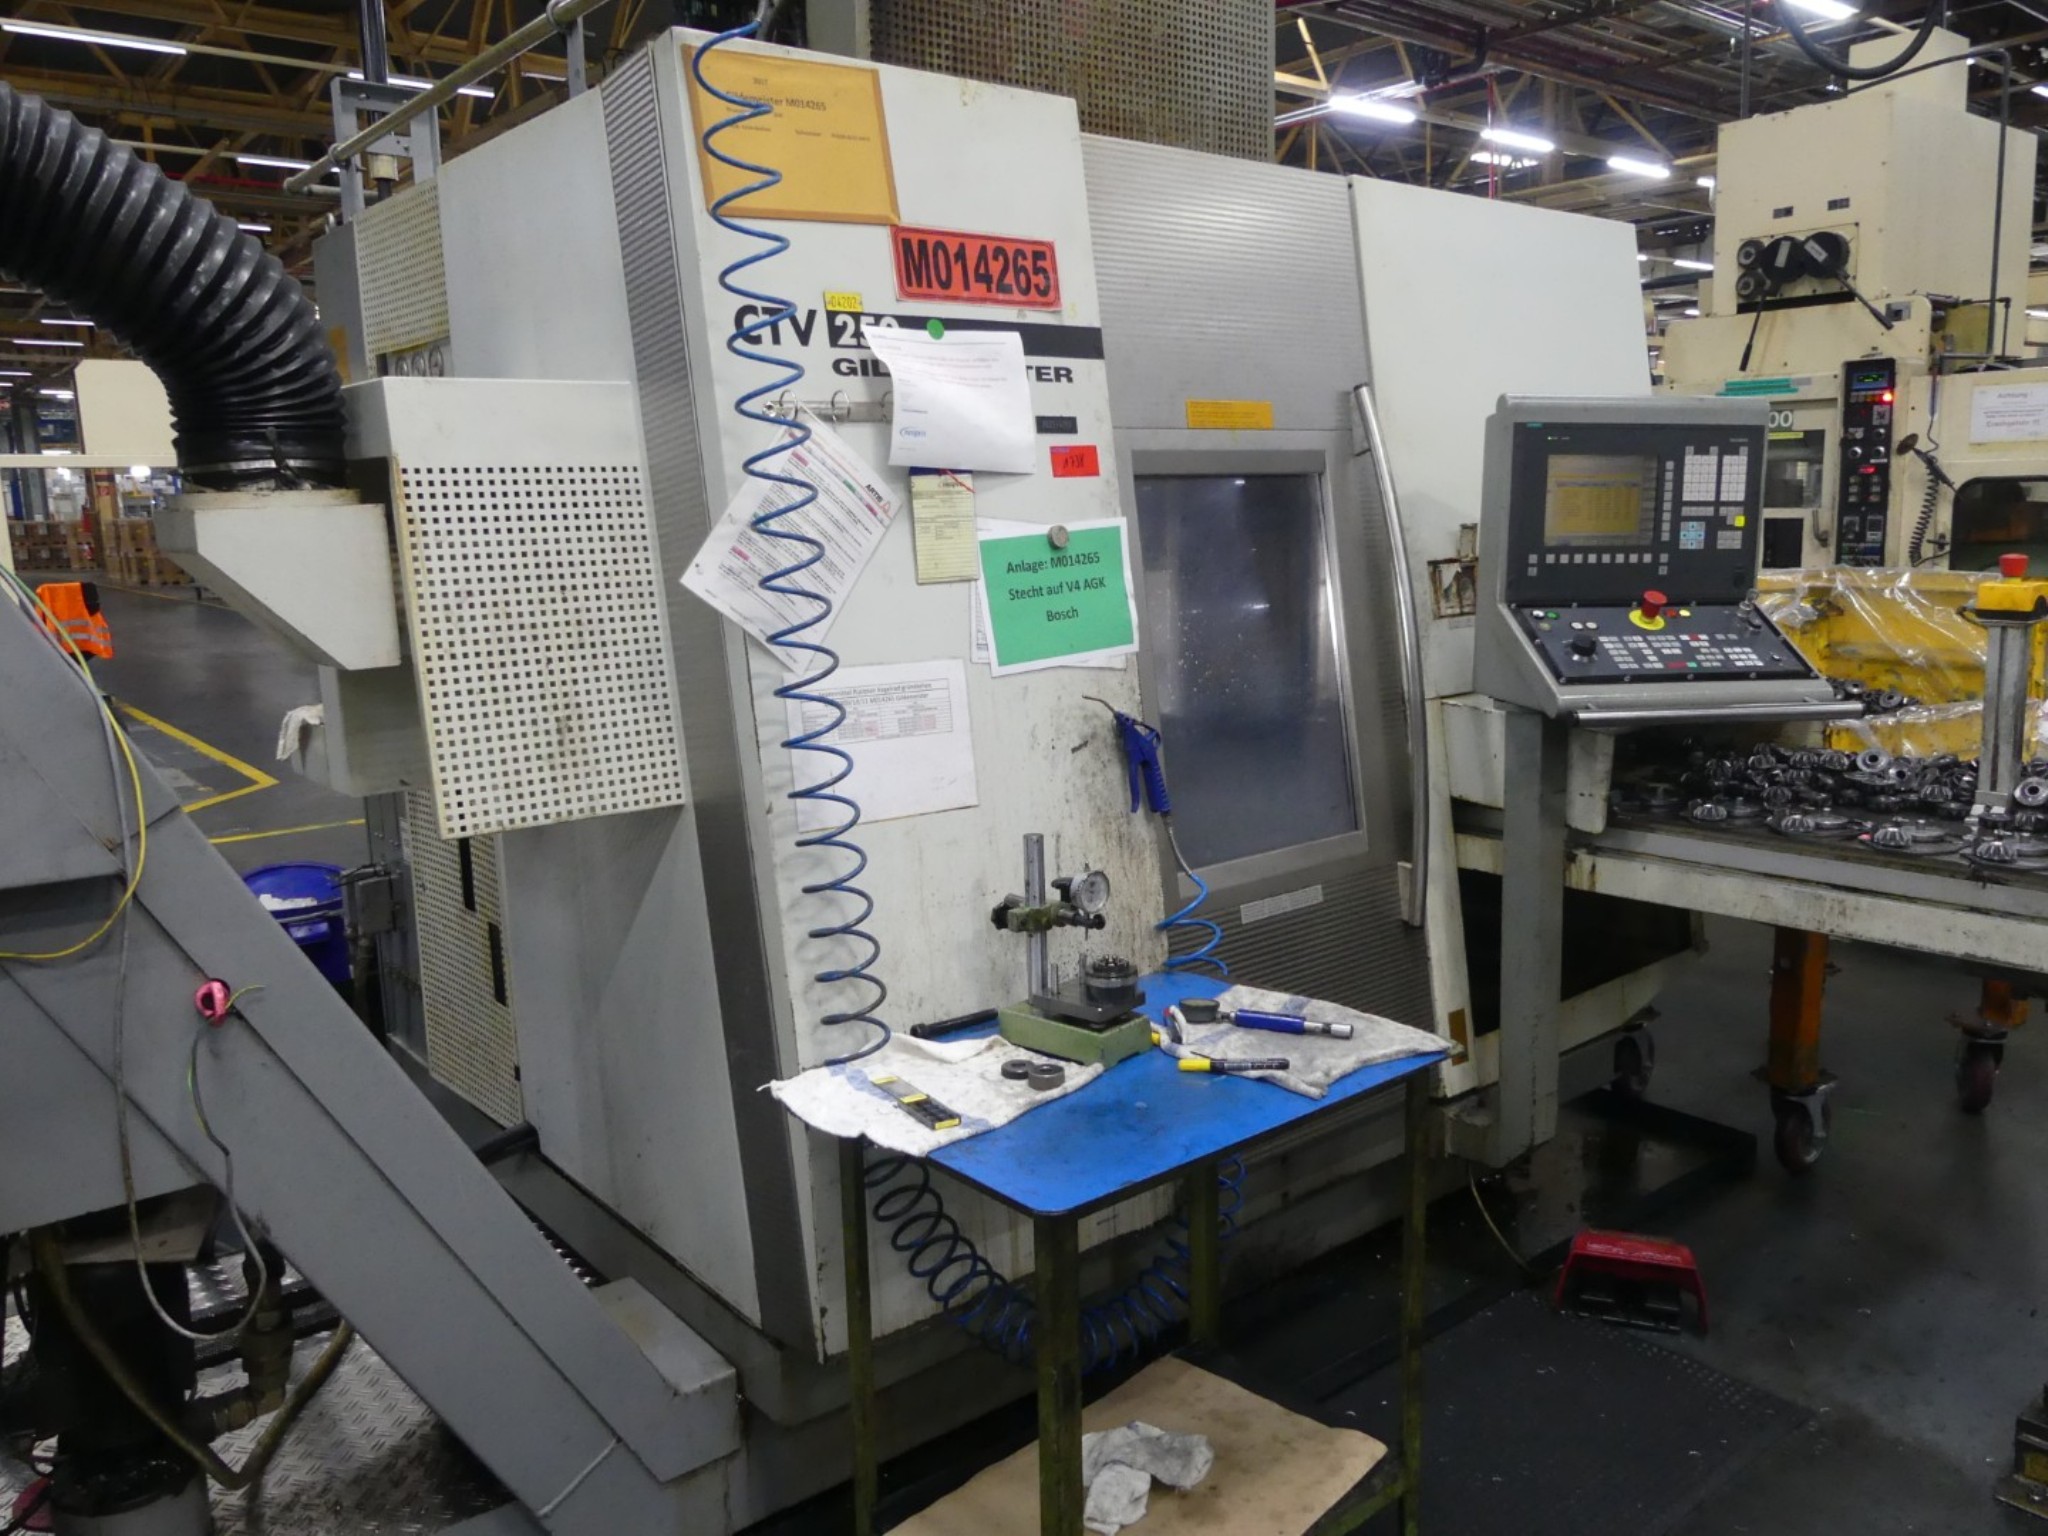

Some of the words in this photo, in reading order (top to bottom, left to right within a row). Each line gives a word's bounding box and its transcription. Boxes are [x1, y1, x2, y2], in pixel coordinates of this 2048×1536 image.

[901, 238, 1050, 297] M014265
[734, 304, 817, 347] CTV
[1006, 560, 1048, 574] Anlage:
[1050, 552, 1100, 569] M014265
[1008, 585, 1044, 601] Stecht
[1046, 582, 1064, 596] auf
[1065, 580, 1081, 593] V4
[1083, 576, 1106, 591] AGK
[1046, 606, 1079, 621] Bosch
